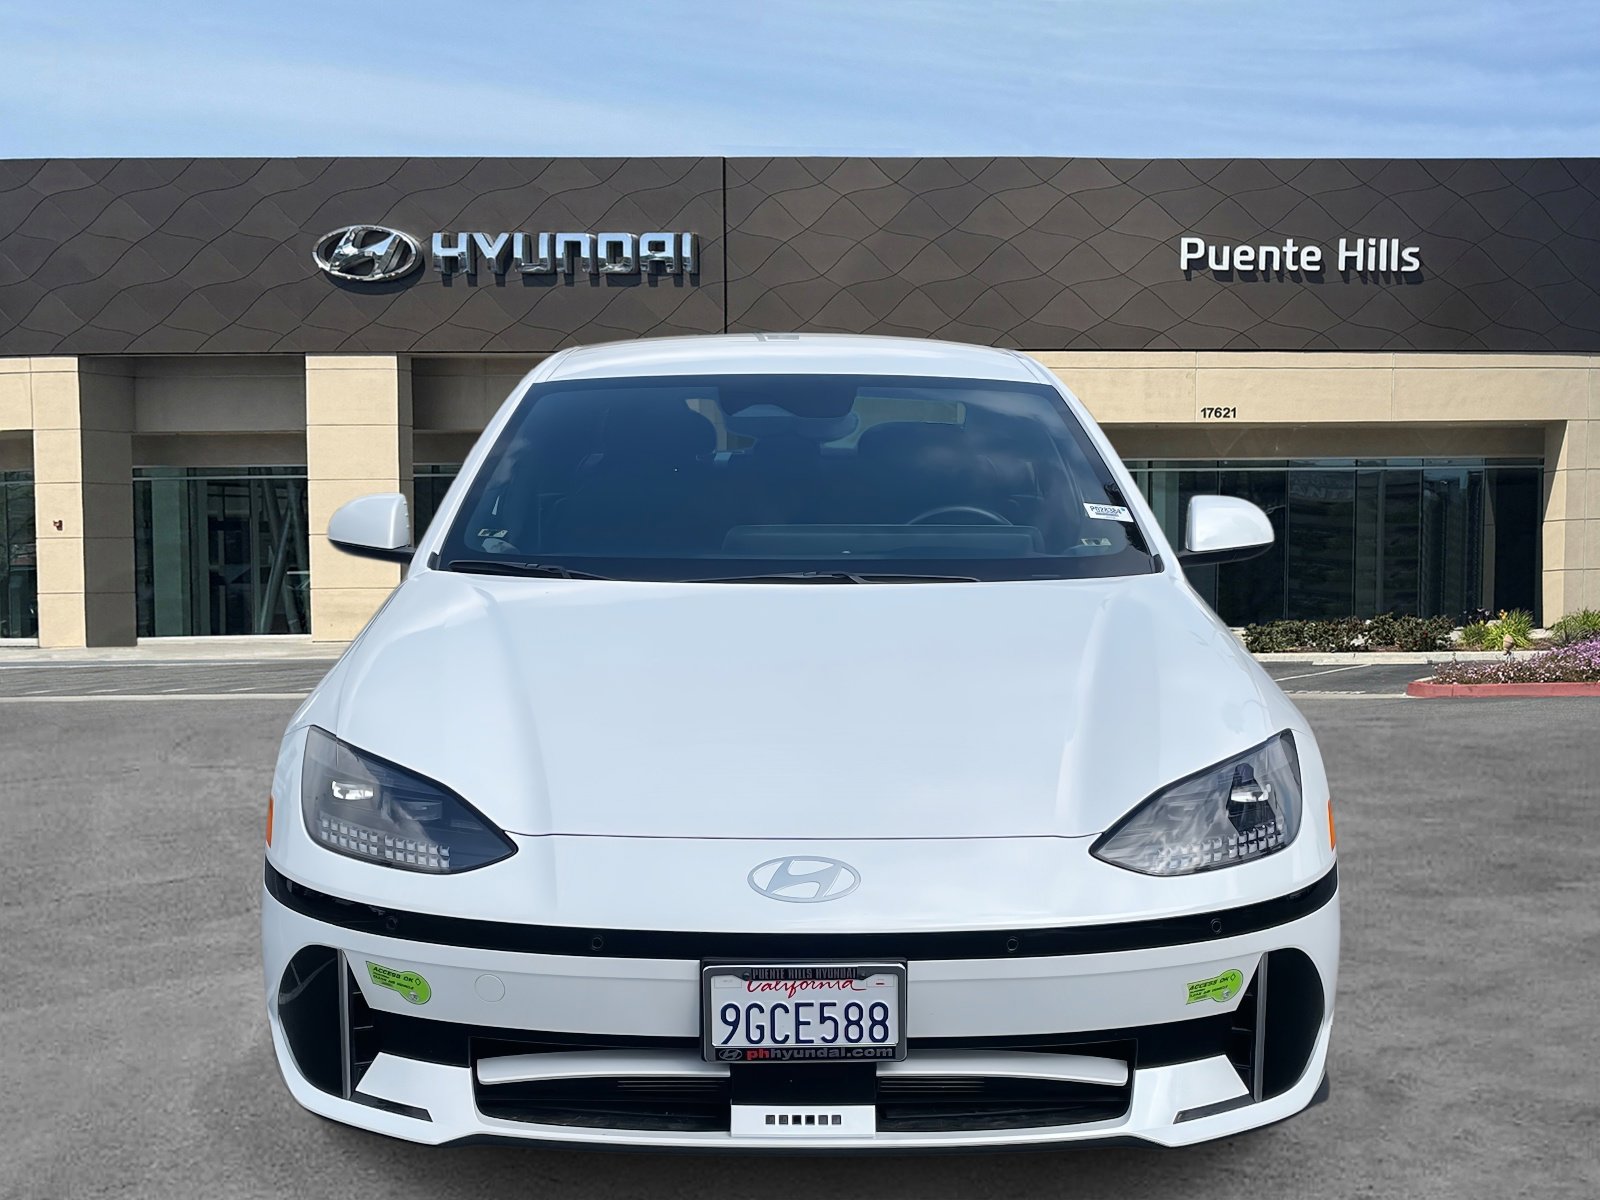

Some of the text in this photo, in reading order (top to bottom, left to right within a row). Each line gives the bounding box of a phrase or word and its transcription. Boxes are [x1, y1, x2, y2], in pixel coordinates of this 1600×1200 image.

[432, 232, 700, 274] HYUNDAI
[1180, 237, 1420, 272] Puente Hills
[1200, 407, 1237, 419] 17621
[752, 967, 857, 980] PUENTE HILLS HYUNDAI
[720, 1001, 889, 1045] 9GCE588
[747, 1047, 893, 1060] phhyundai.com
